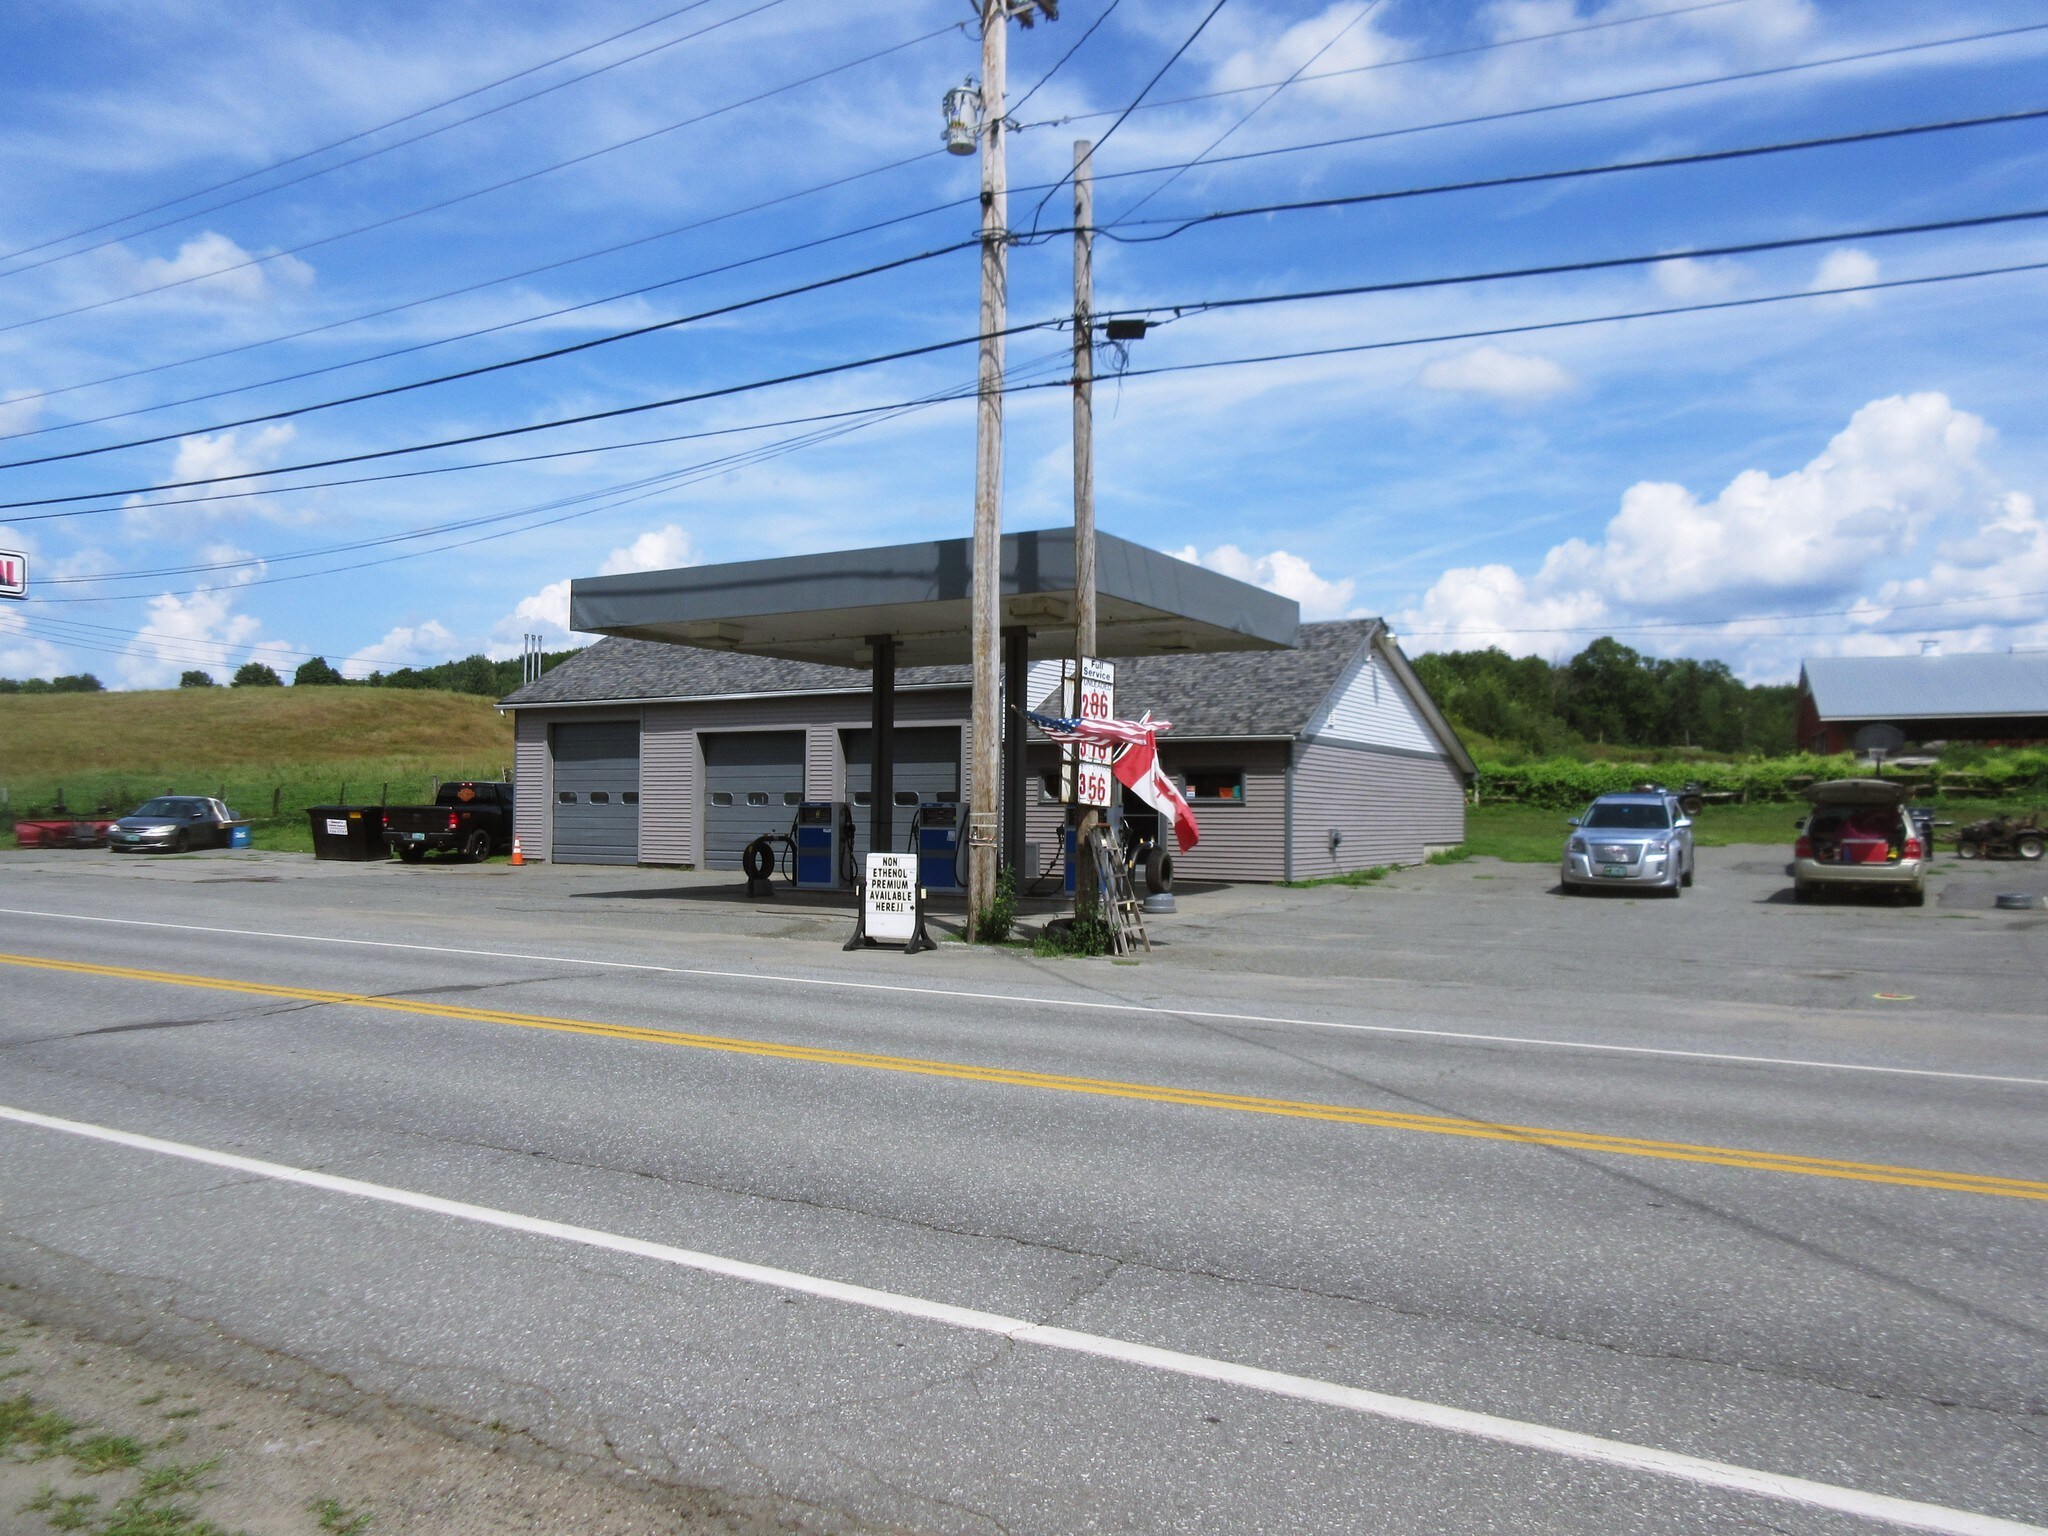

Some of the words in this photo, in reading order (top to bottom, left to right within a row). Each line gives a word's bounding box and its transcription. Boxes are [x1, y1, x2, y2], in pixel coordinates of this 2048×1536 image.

[1091, 660, 1104, 670] Full
[1083, 667, 1111, 681] Service
[1082, 692, 1108, 718] 286
[1079, 773, 1106, 801] 356
[883, 857, 898, 867] NON
[873, 868, 907, 878] ETHENOL
[871, 879, 909, 890] PREMIUM
[870, 890, 912, 901] AVAILABLE
